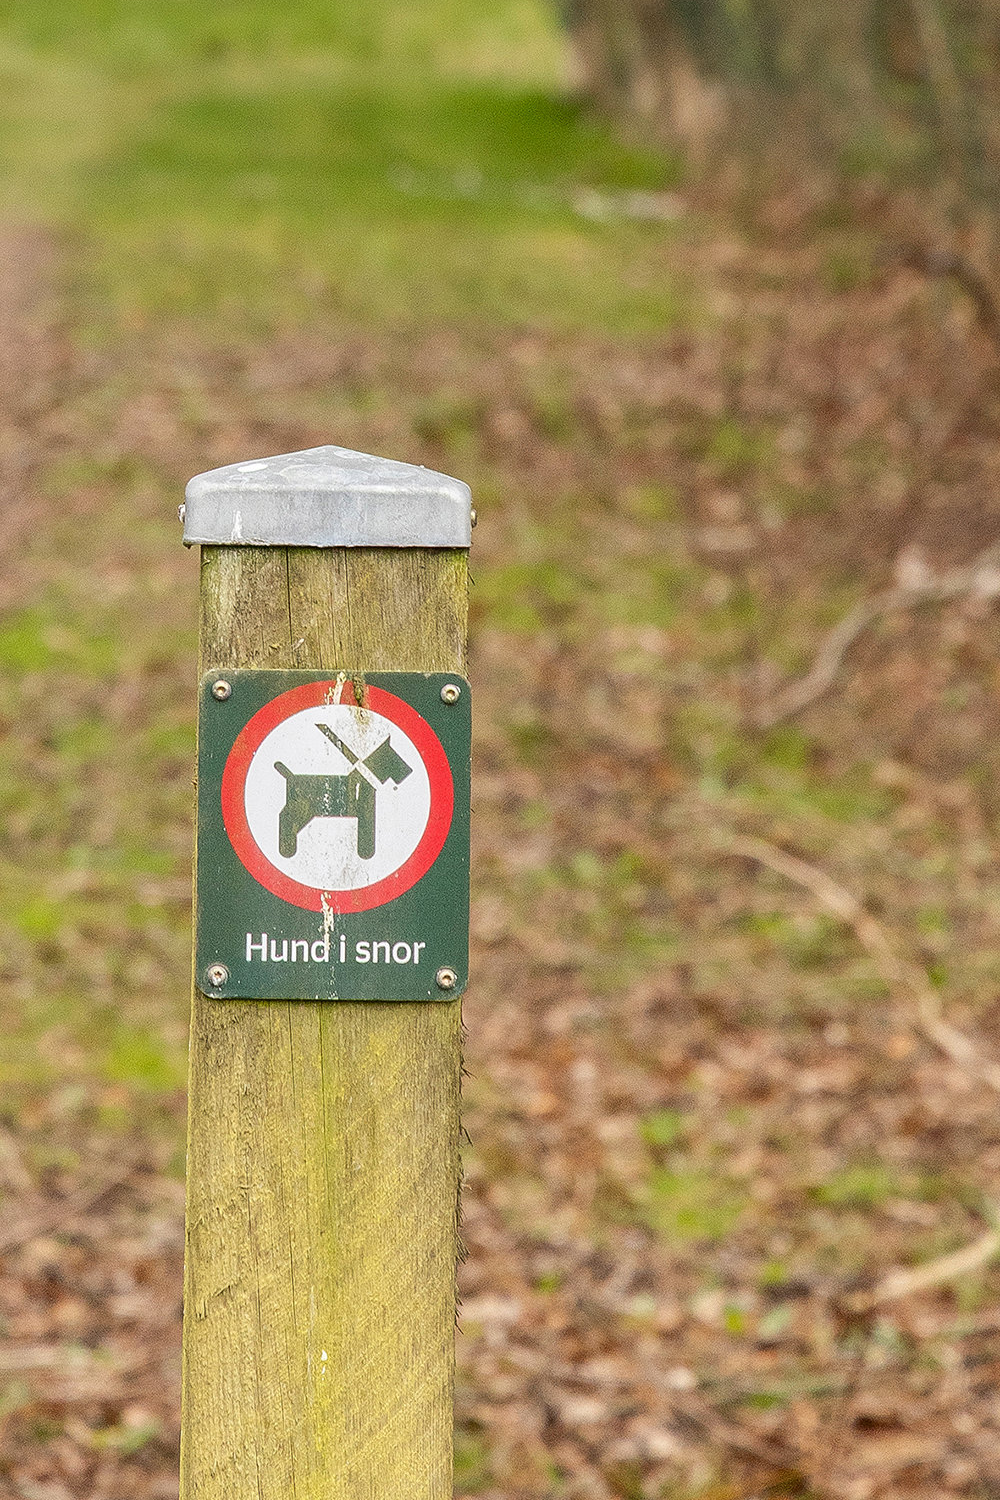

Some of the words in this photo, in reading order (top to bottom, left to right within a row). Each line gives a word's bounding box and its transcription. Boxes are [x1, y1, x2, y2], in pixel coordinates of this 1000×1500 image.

[246, 932, 330, 963] Hund
[339, 934, 346, 963] i
[355, 941, 426, 964] snor
